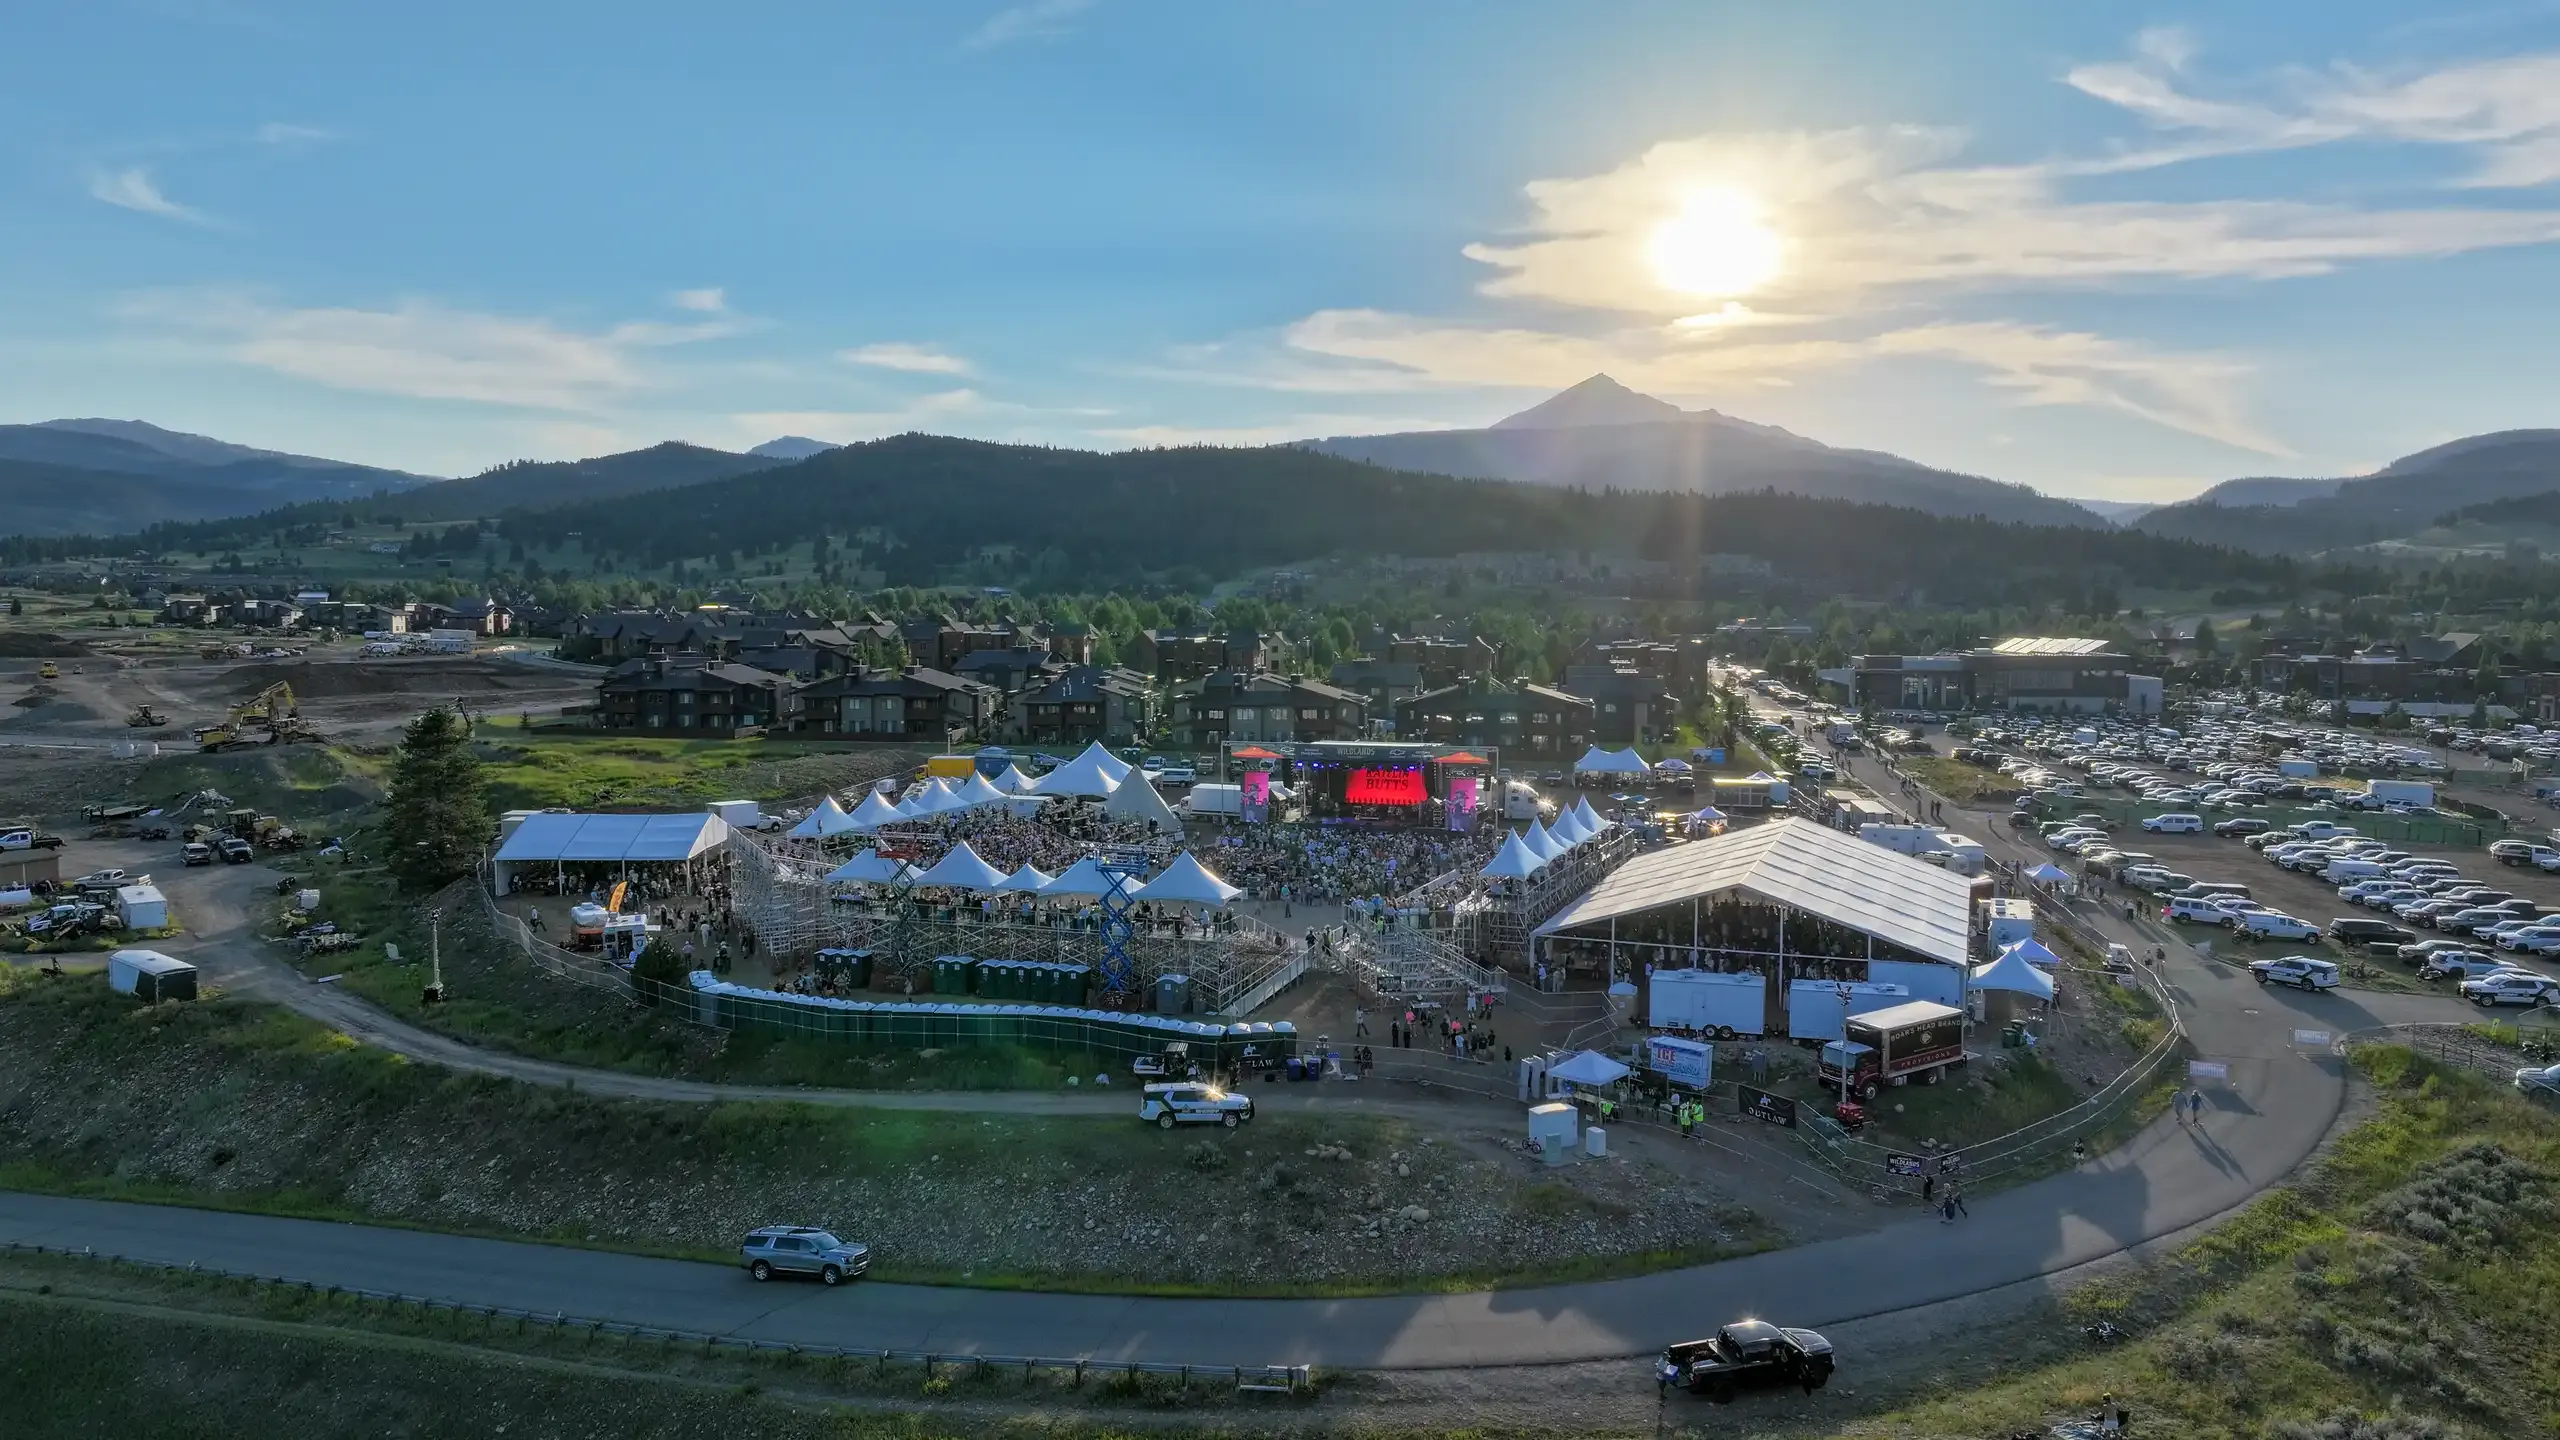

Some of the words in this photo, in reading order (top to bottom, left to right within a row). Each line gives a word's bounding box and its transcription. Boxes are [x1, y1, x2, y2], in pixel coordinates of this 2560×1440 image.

[1337, 747, 1375, 756] WILDLANDS
[1365, 779, 1409, 790] BUTTS
[1917, 1022, 1936, 1032] HEAD
[1937, 1019, 1960, 1028] BRAND
[1901, 1051, 1951, 1068] PROVISIONS
[1748, 1106, 1787, 1125] OUTLAW
